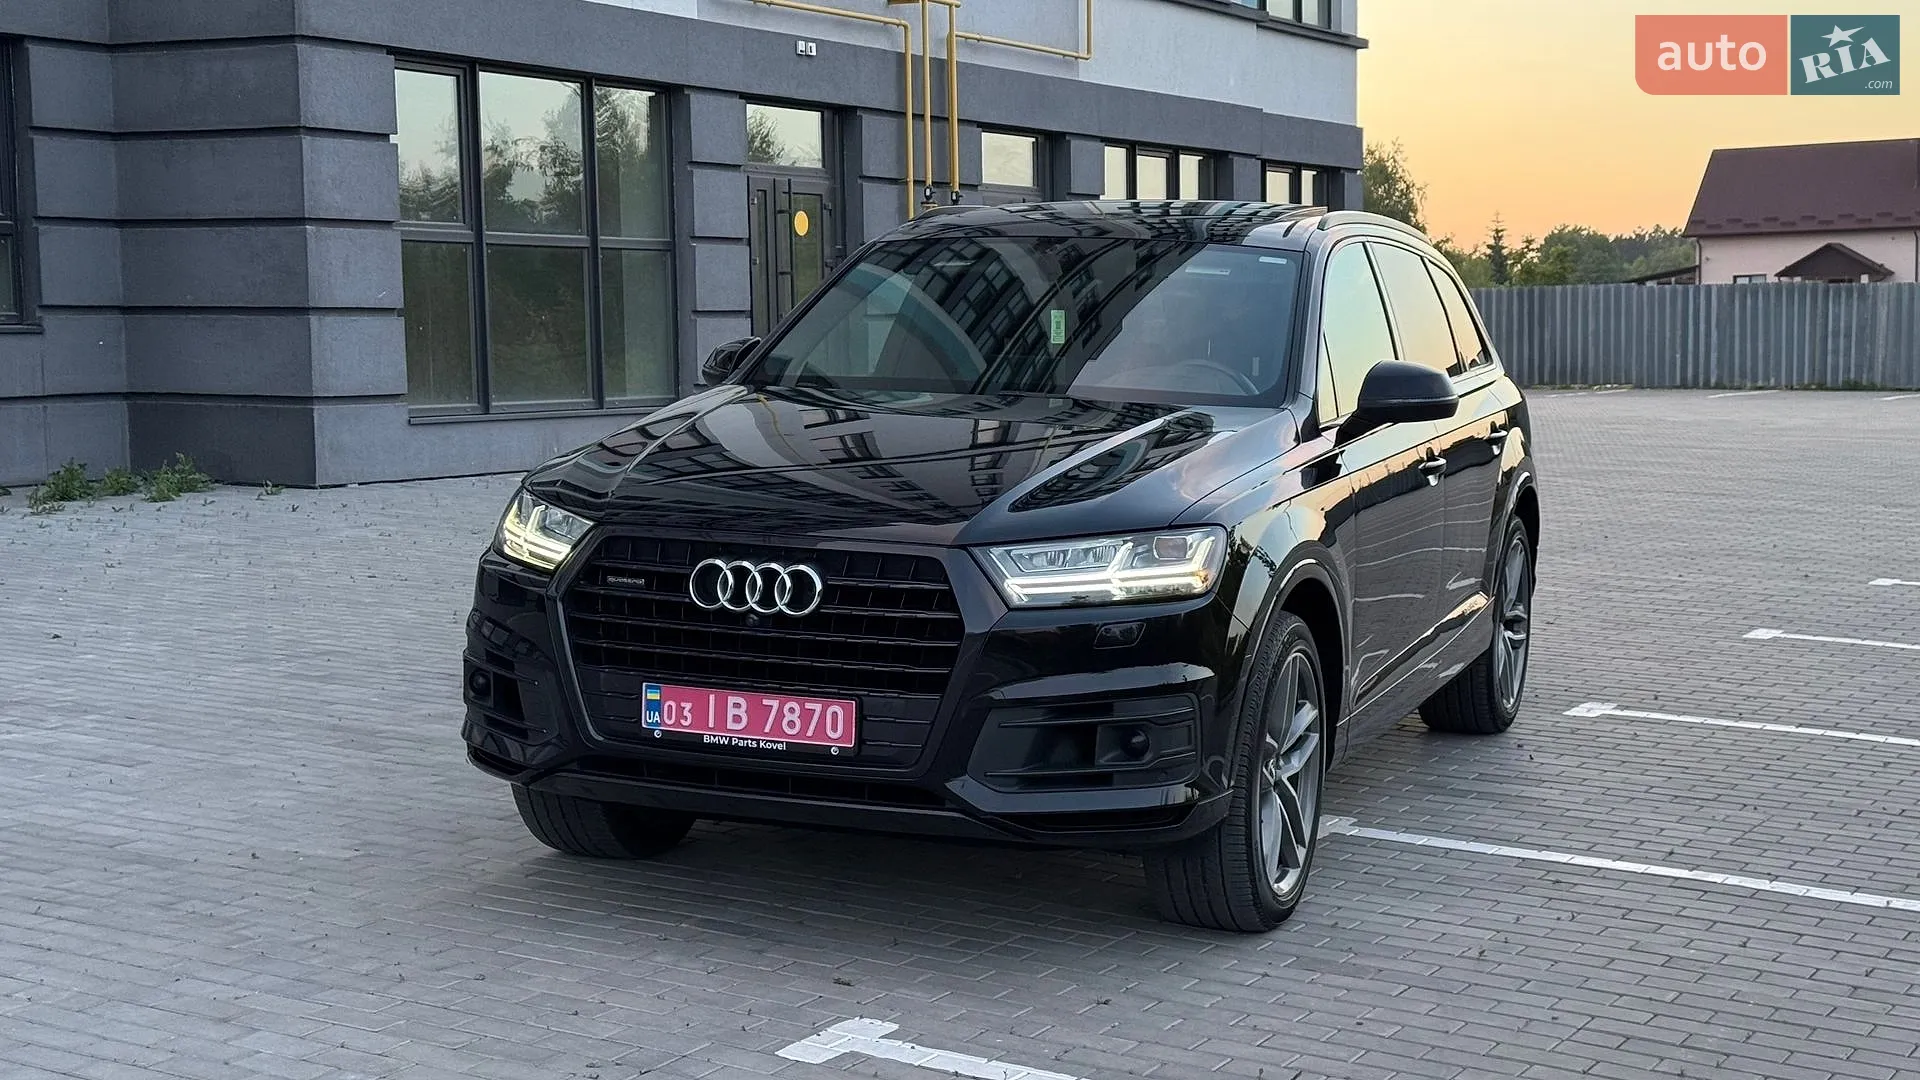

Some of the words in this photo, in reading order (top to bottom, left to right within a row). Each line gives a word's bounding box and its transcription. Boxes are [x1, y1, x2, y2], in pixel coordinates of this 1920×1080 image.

[646, 711, 661, 723] UA
[663, 700, 692, 727] 03
[762, 699, 844, 740] 7870
[703, 734, 729, 745] BMW
[732, 737, 757, 748] Parts
[760, 740, 786, 751] Kovel
